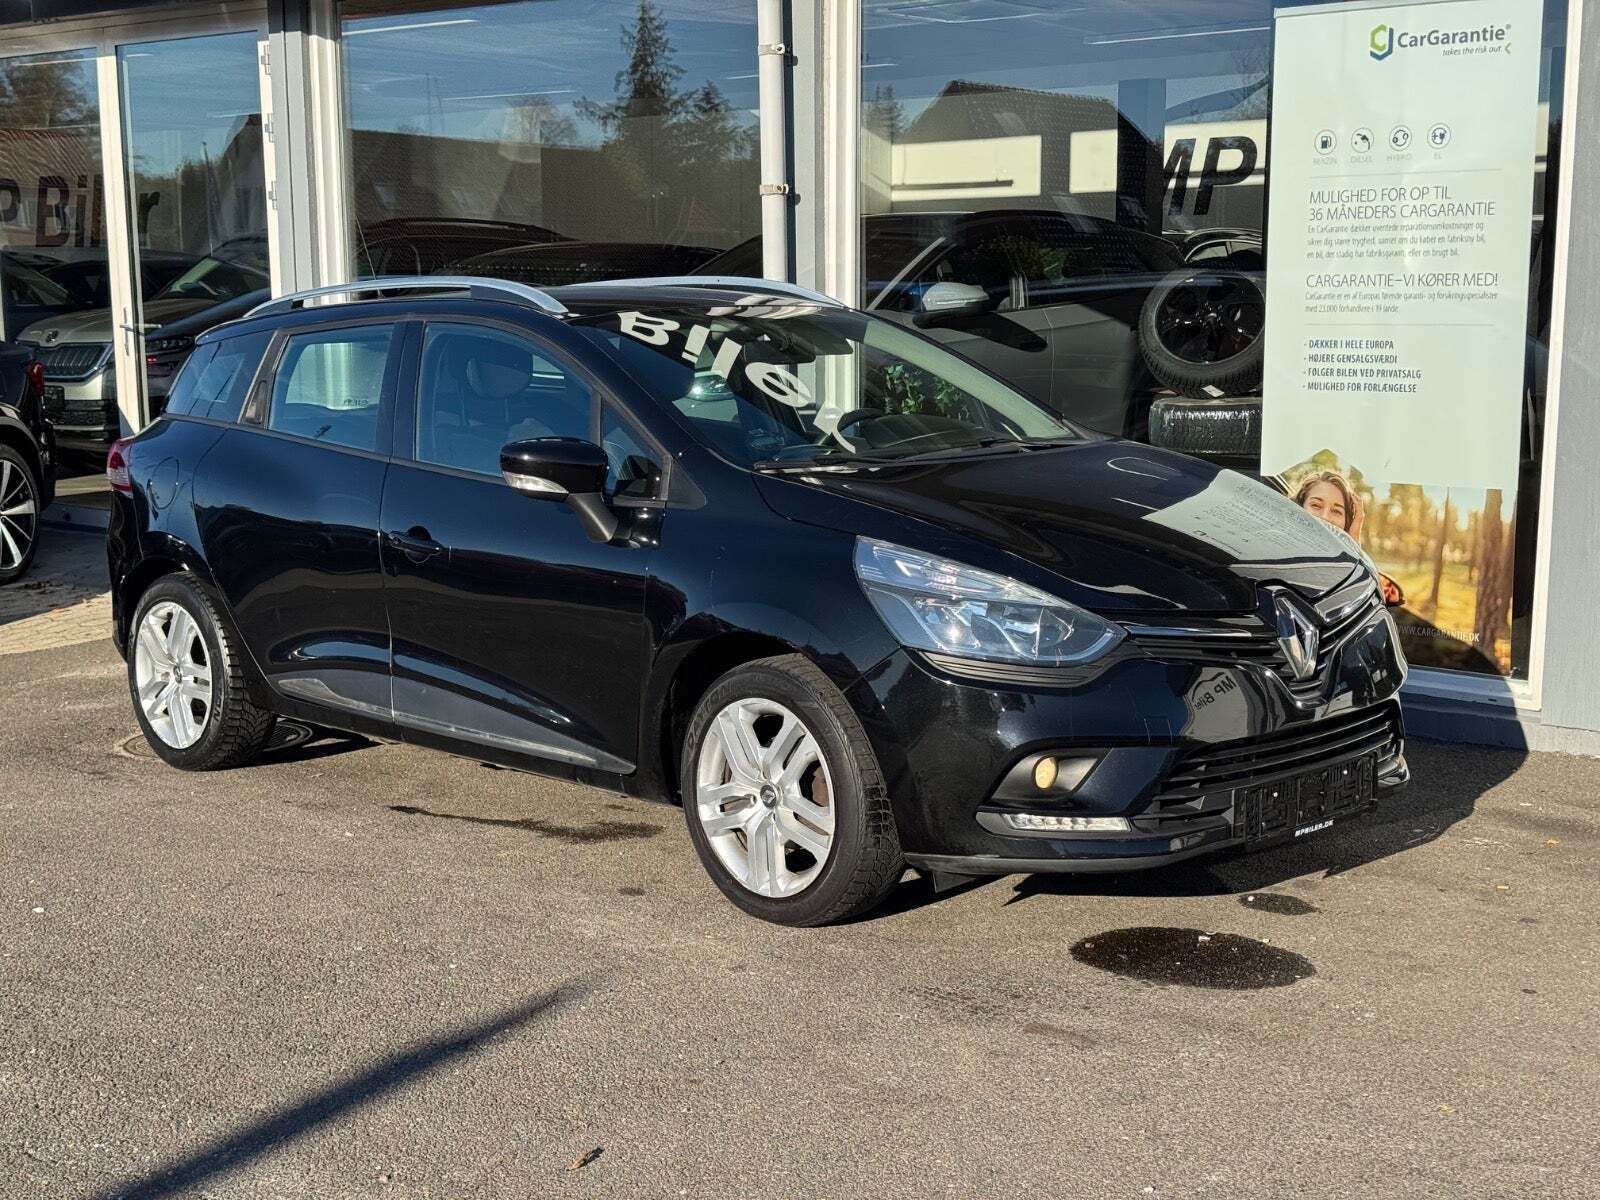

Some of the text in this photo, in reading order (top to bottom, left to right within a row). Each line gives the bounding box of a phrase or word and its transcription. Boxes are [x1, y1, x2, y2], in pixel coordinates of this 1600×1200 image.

[1397, 25, 1505, 48] CarGarantie
[1442, 48, 1461, 56] takes
[1462, 48, 1474, 56] the
[1475, 46, 1488, 54] risk
[1310, 186, 1452, 204] MULIGHED FOR OP TIL
[1310, 202, 1495, 221] 36 MÅNEDERS CARGARANTIE
[1418, 272, 1460, 286] KØRER
[1463, 272, 1498, 286] MED!
[1309, 340, 1338, 348] DÆKKER
[1346, 340, 1363, 349] HELE
[1366, 340, 1394, 349] EUROPA
[1308, 354, 1398, 364] HØJERE GENSALGSVÆRDI
[1308, 368, 1422, 379] FØLGER BILEN VED PRIVATSALG
[1308, 382, 1417, 392] MULIGHED FOR FORLÆNGELSE
